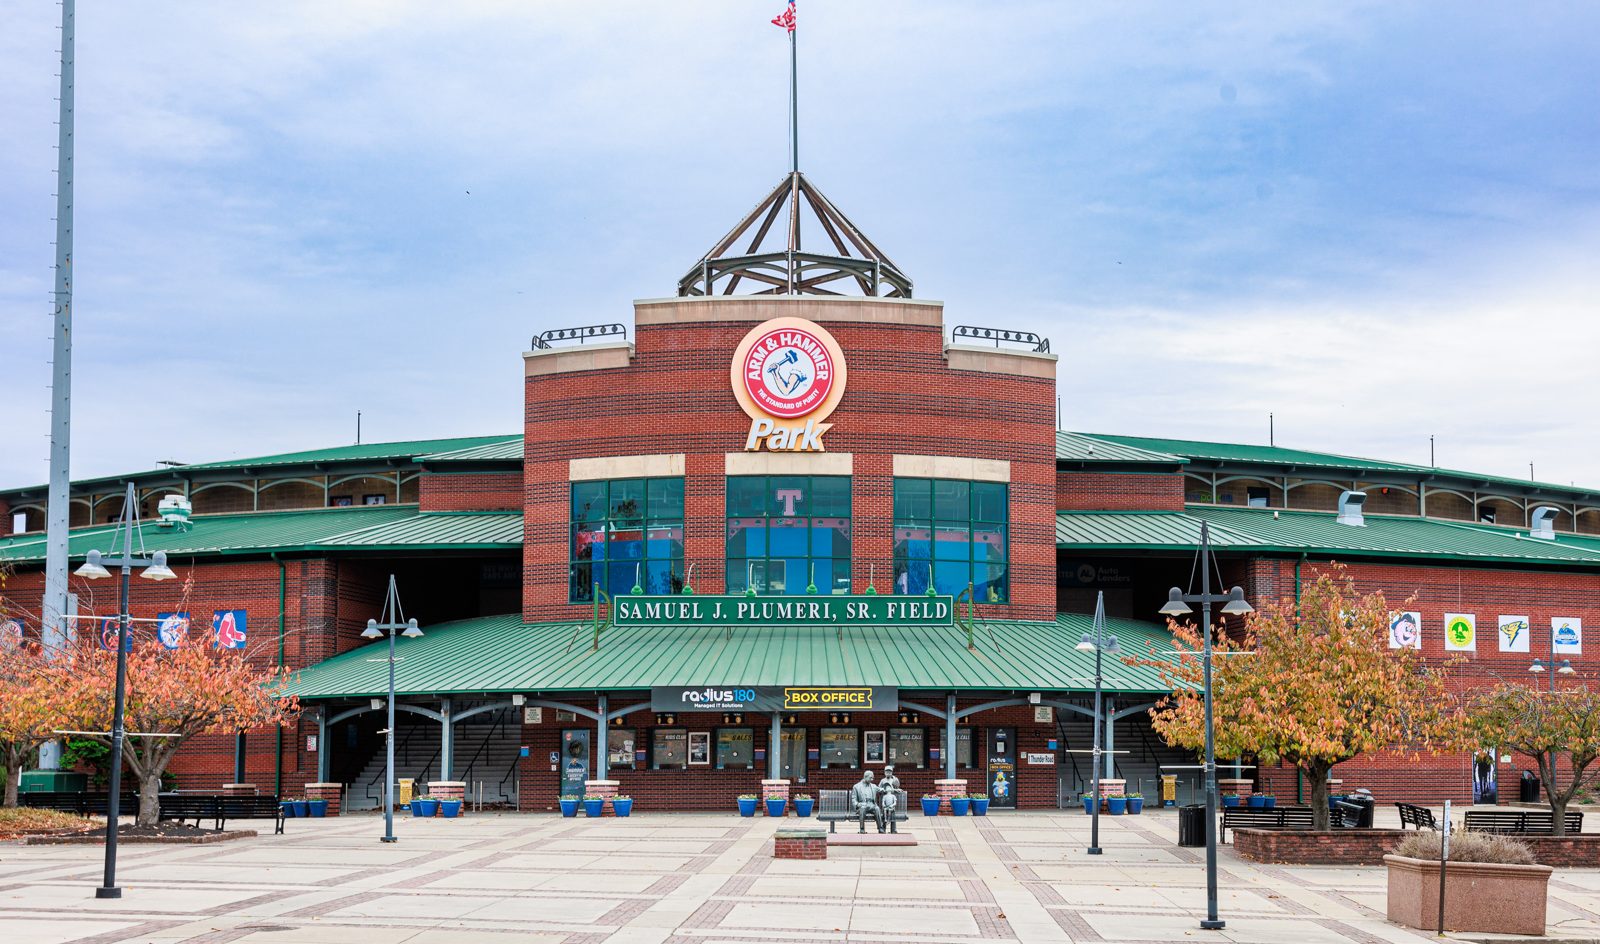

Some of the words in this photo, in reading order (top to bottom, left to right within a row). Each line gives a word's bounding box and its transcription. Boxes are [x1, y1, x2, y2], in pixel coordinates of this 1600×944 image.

[748, 345, 768, 380] ARM
[765, 337, 779, 350] &
[780, 333, 828, 380] HAMMER
[758, 388, 768, 399] THE
[766, 396, 795, 409] STANDARD
[802, 388, 820, 405] PURITY
[747, 418, 824, 451] Park
[777, 489, 802, 516] T
[1097, 566, 1119, 574] Auto
[1097, 574, 1131, 582] Lenders
[619, 602, 704, 619] SAMUEL
[712, 602, 727, 619] J.
[737, 602, 837, 622] PLUMERI,
[846, 602, 877, 619] SR.
[886, 602, 948, 619] FIELD
[682, 688, 755, 702] radius180
[791, 692, 818, 703] BOX
[821, 692, 865, 703] OFFICE
